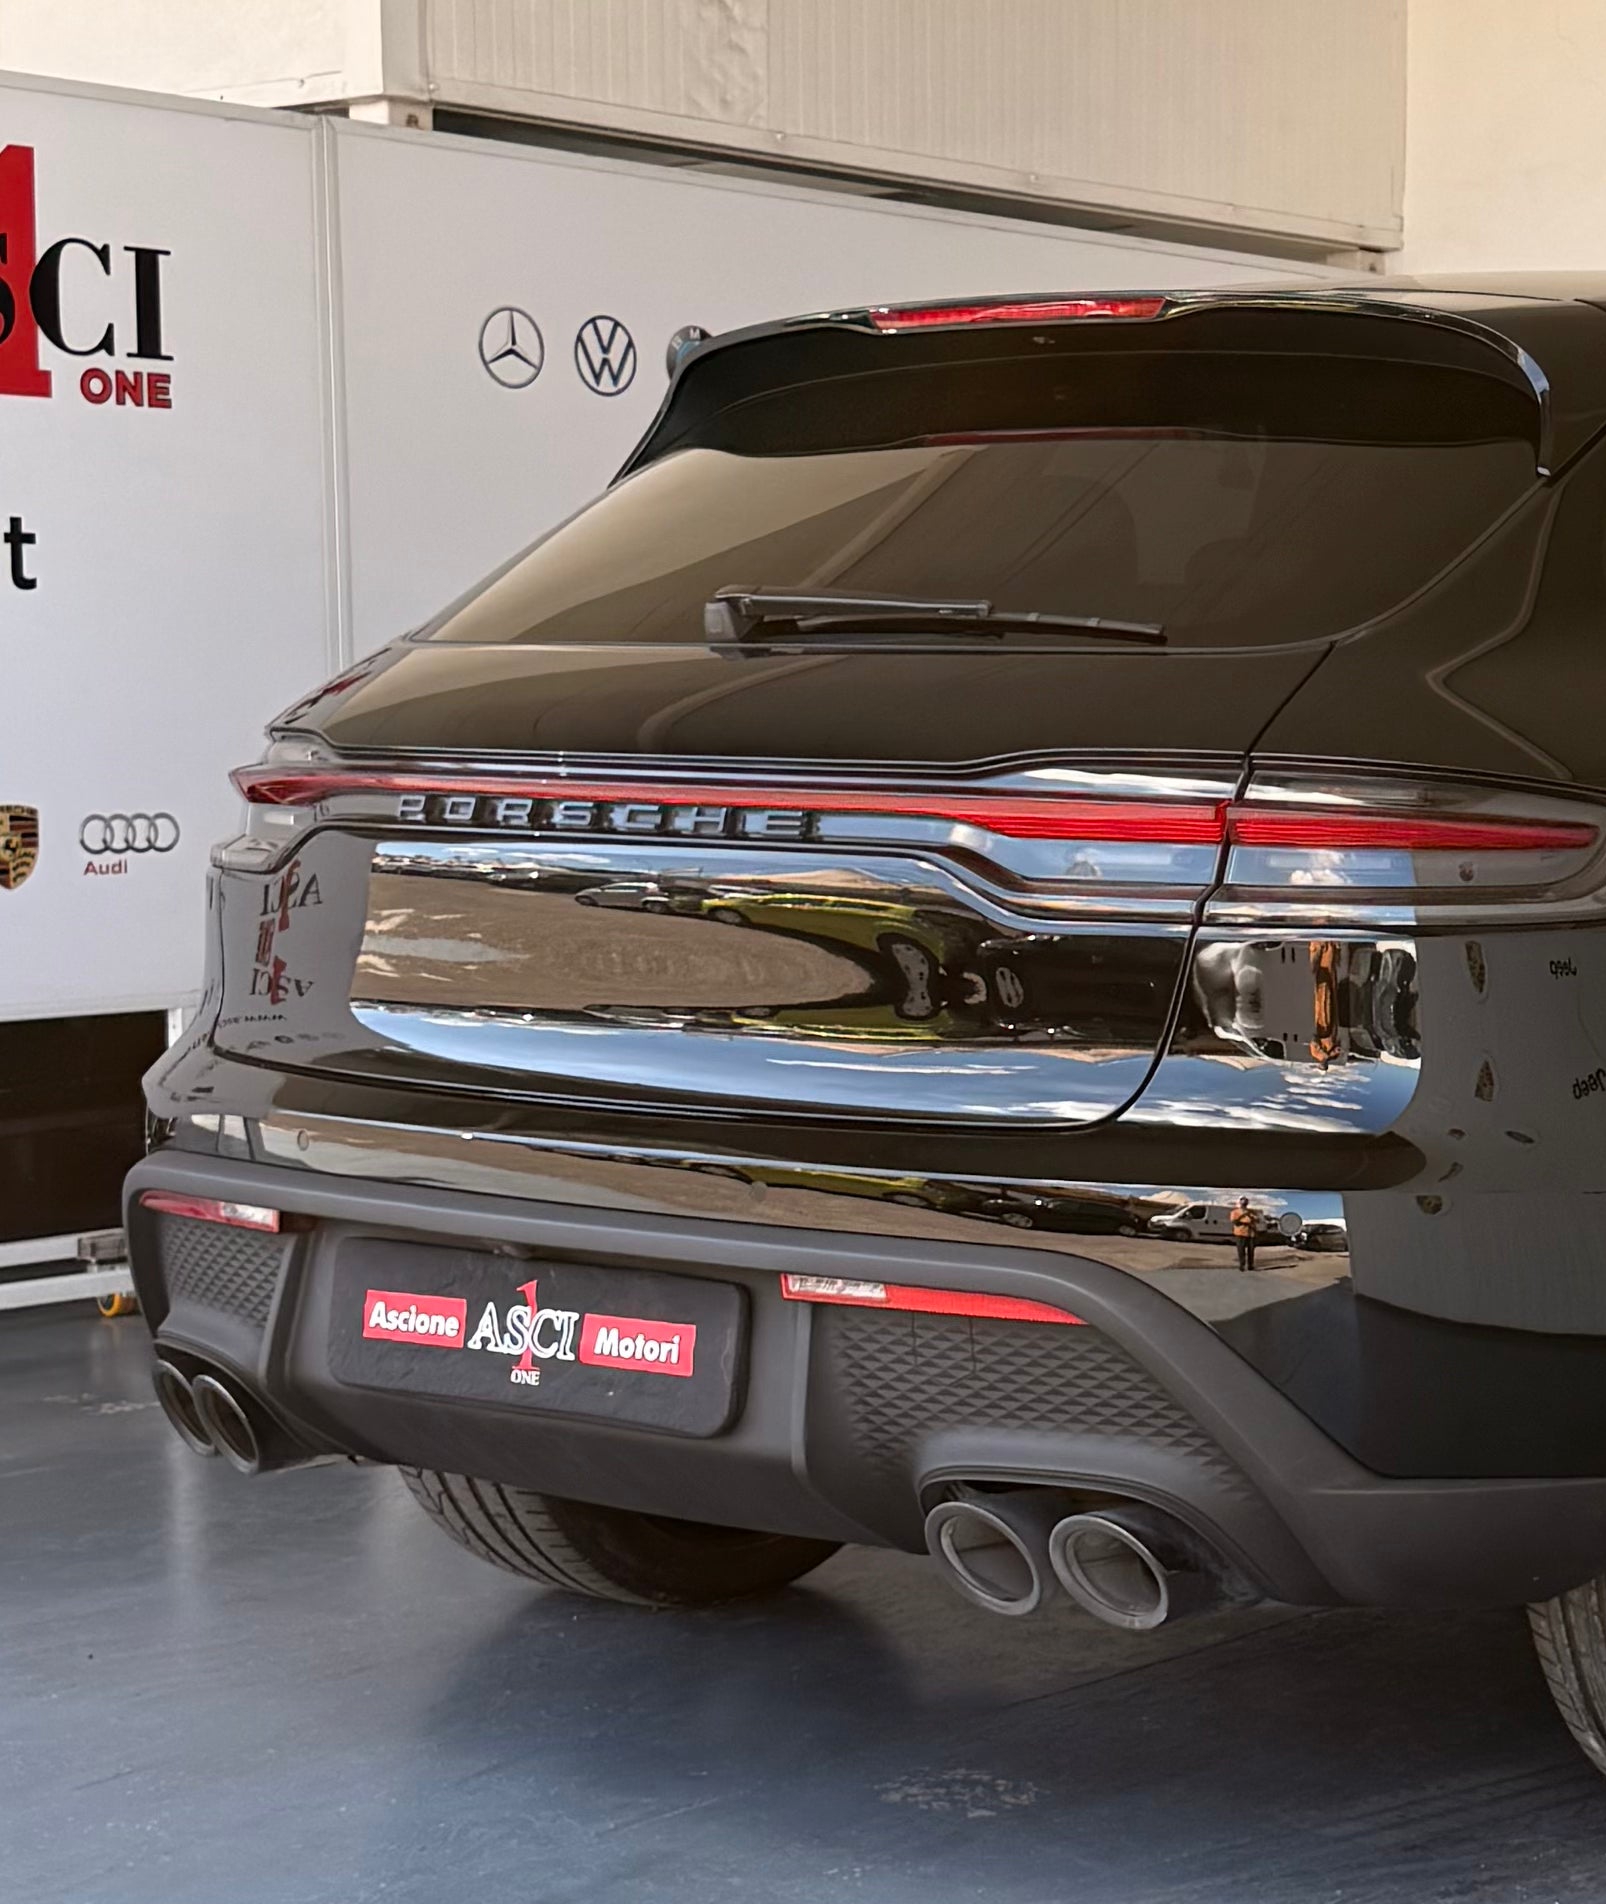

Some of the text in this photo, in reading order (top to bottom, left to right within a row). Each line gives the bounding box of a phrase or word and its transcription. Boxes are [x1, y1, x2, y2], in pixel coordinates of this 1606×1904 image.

[80, 368, 173, 409] ONE
[398, 795, 803, 836] PORSCHE
[83, 859, 128, 876] Audi
[369, 1301, 681, 1364] Ascione ASCI Motori
[510, 1369, 541, 1386] ONE
